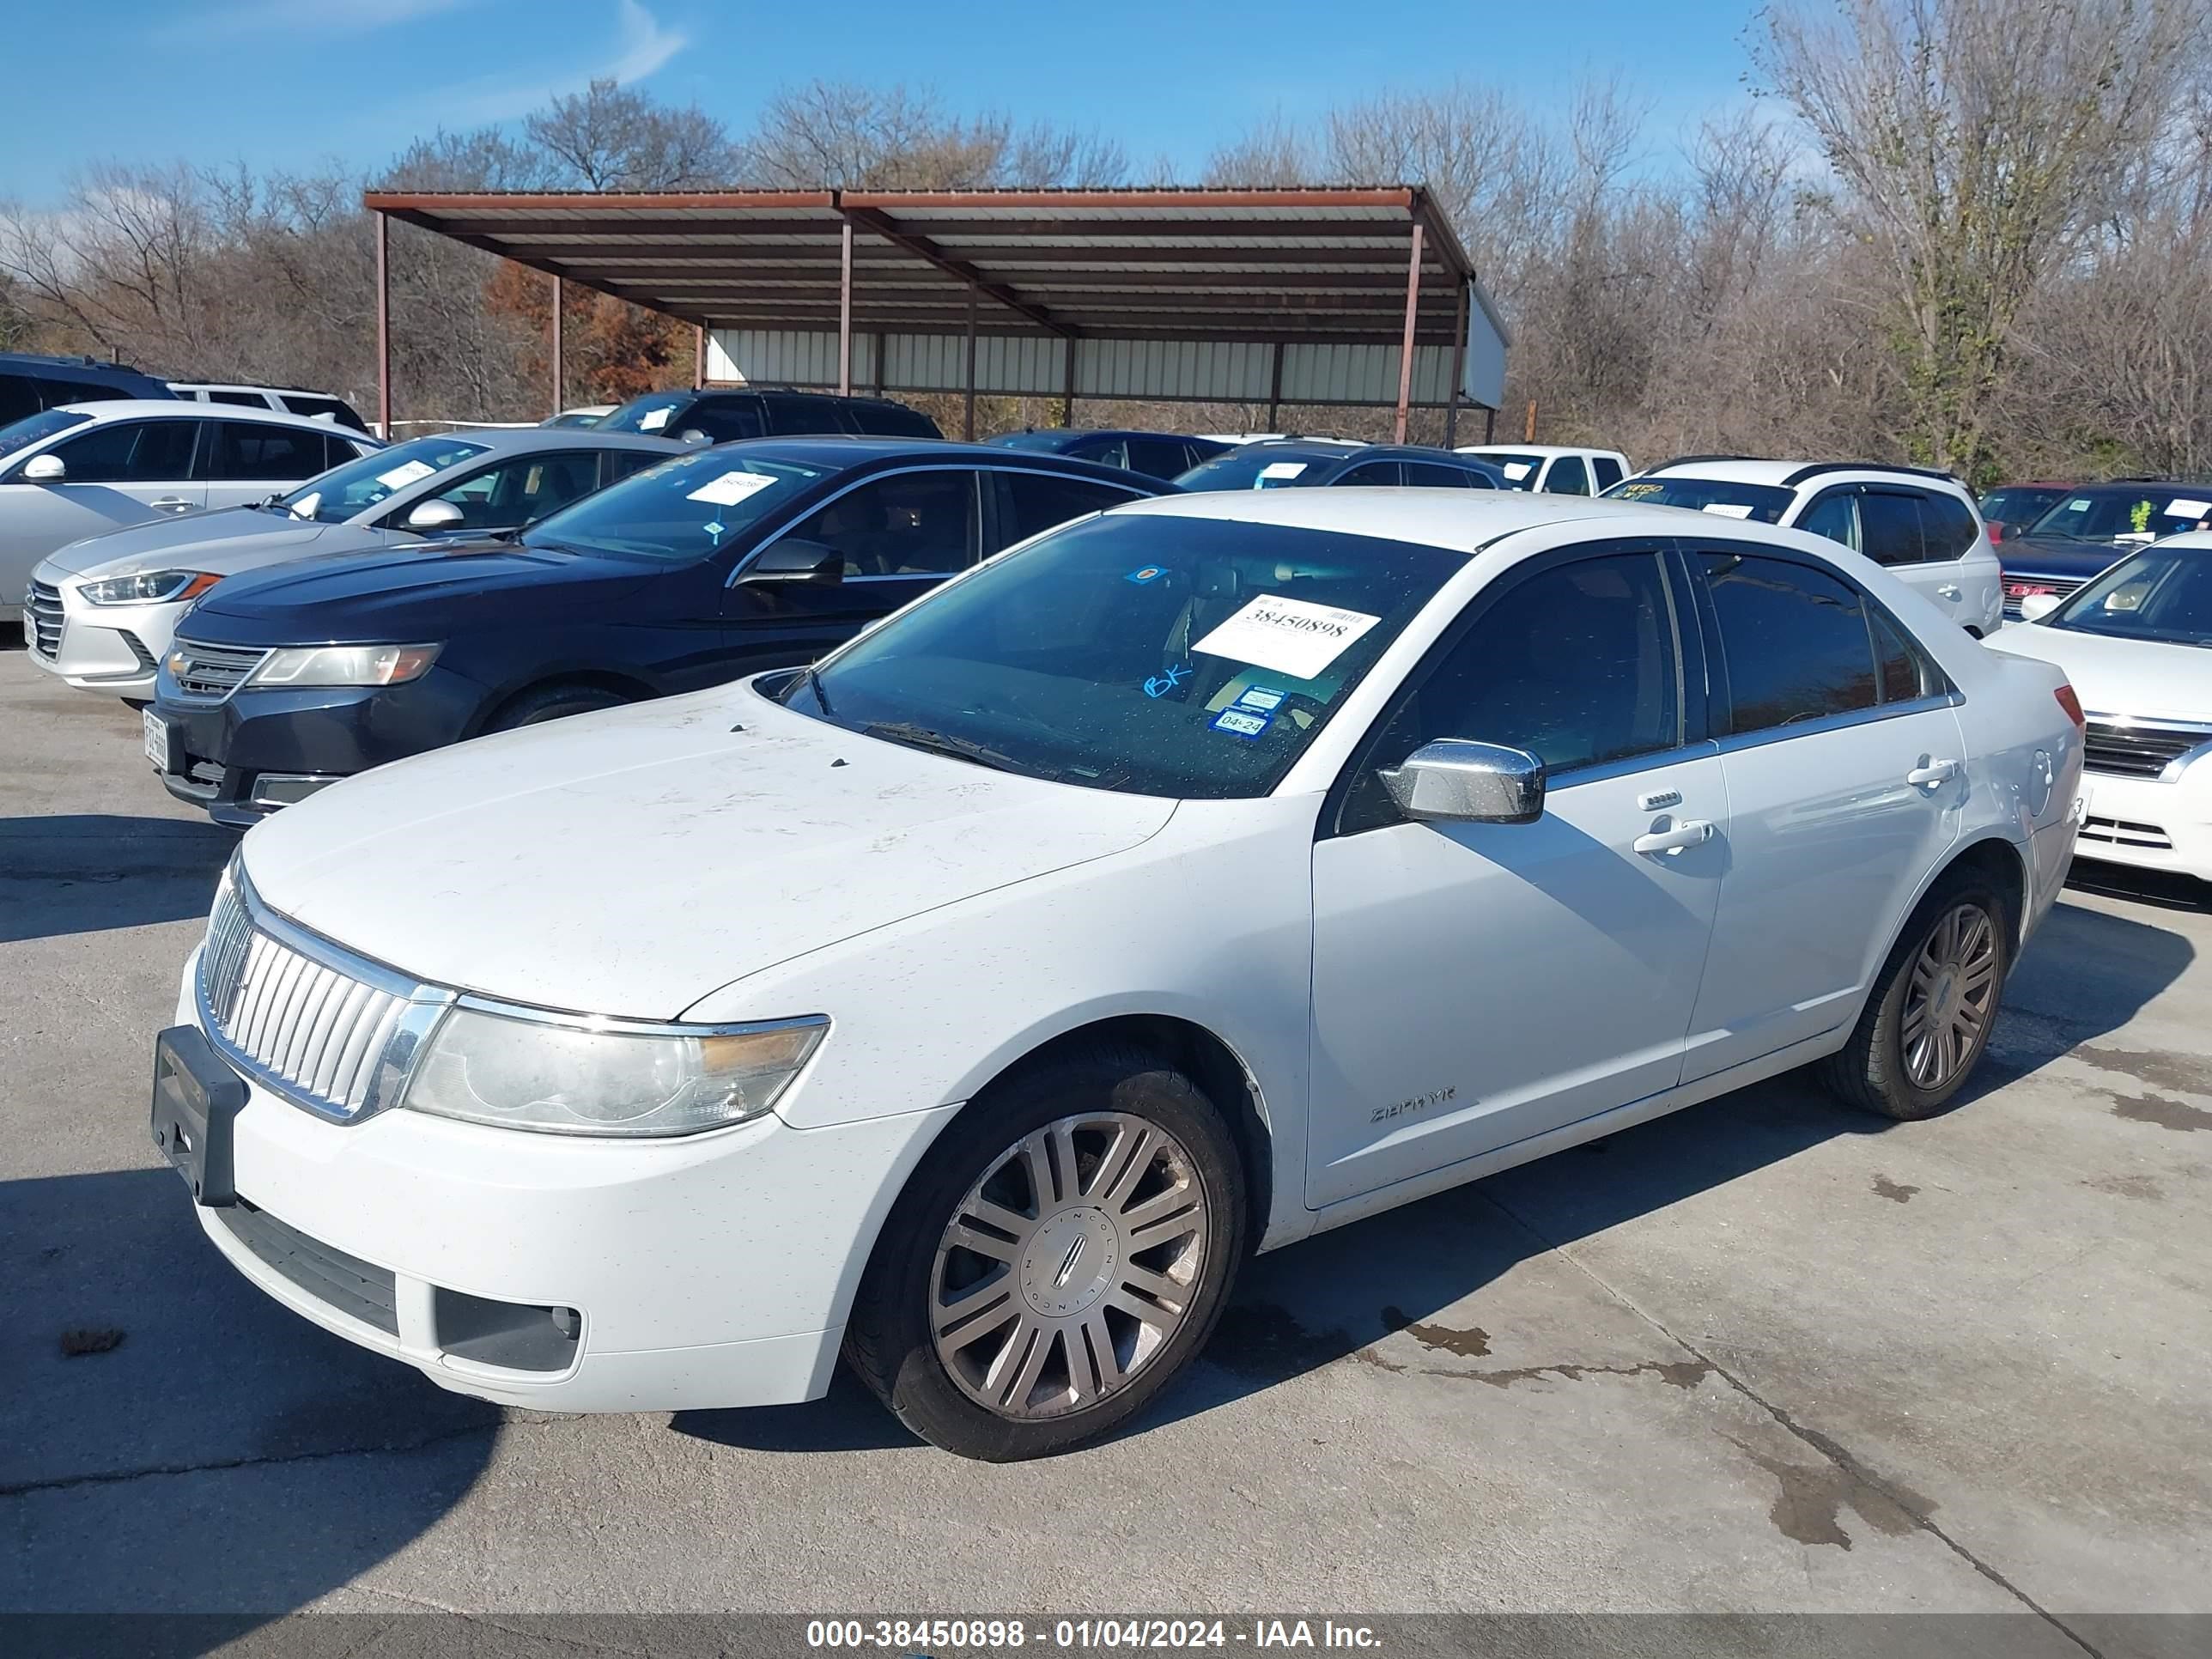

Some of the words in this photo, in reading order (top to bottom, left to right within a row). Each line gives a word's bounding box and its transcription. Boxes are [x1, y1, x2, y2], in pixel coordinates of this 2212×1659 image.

[1246, 609, 1349, 638] 38450898
[1143, 664, 1193, 698] BK
[1370, 1085, 1456, 1123] ZEPHYR
[1043, 1212, 1113, 1264] LINCOLN
[1025, 1260, 1096, 1310] LINCOLN
